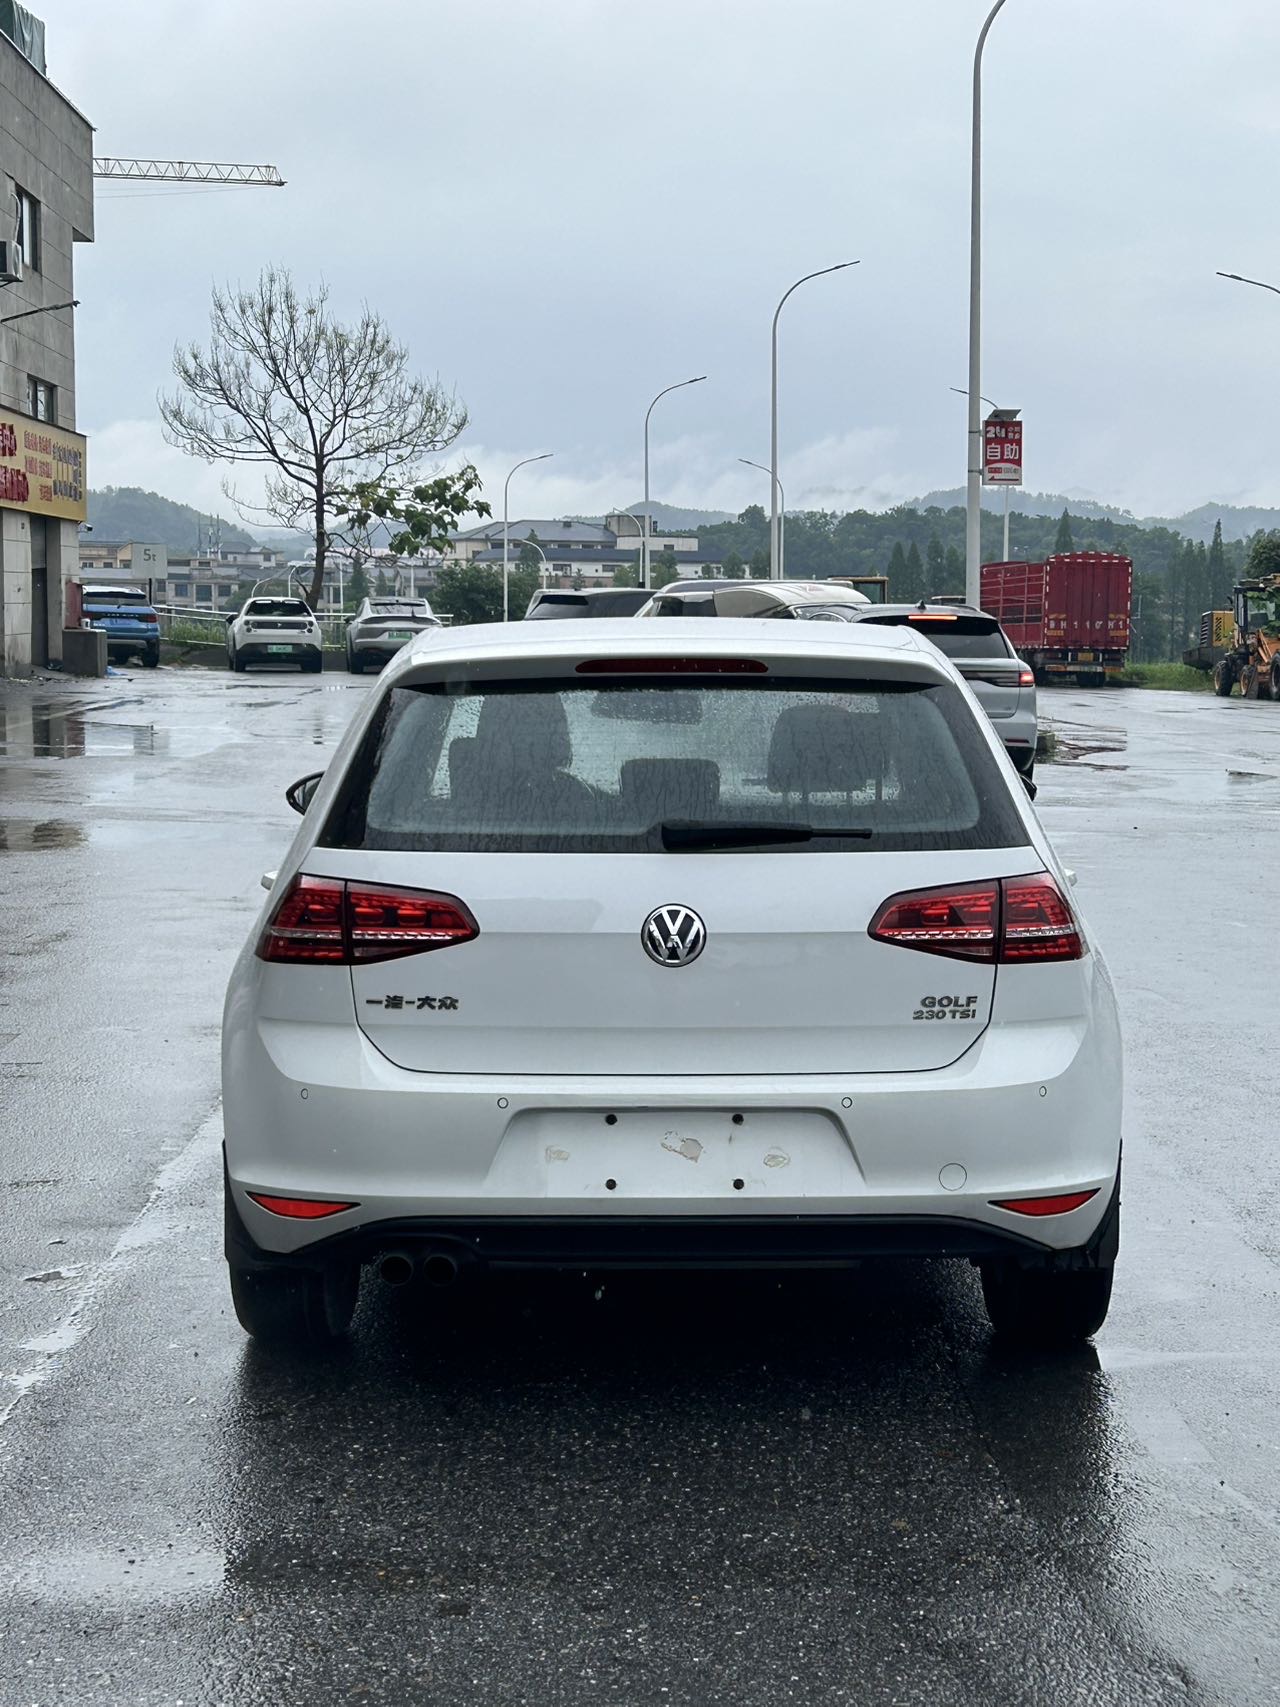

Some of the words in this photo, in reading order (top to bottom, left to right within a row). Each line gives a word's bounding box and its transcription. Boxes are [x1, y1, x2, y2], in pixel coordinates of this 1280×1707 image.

[986, 443, 1019, 460] 自助
[143, 548, 157, 562] 5t
[920, 995, 978, 1008] GOLF
